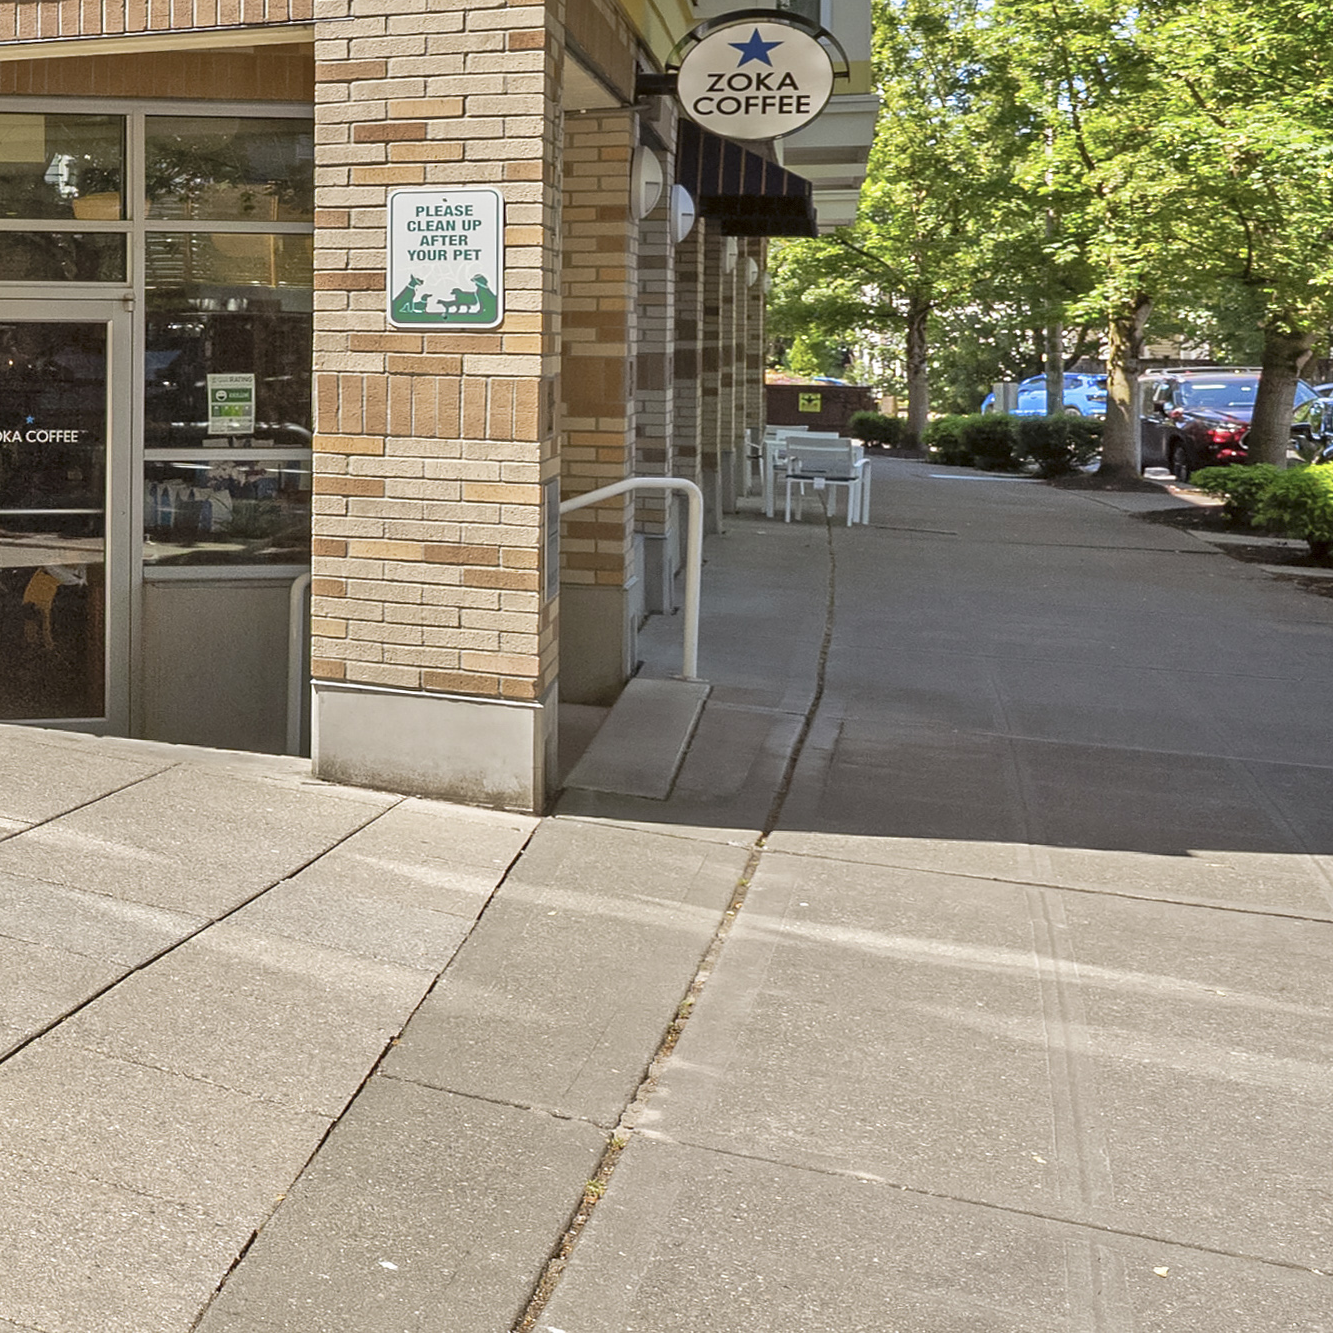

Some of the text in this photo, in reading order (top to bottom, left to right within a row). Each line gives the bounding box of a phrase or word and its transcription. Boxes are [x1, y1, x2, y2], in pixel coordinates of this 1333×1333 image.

[706, 72, 799, 92] ZOKA
[693, 95, 811, 115] COFFEE
[415, 205, 474, 217] PLEASE
[407, 219, 482, 232] CLEAN UP
[419, 234, 469, 246] AFTER
[407, 249, 482, 261] YOUR PET
[25, 429, 79, 443] COFFEE
